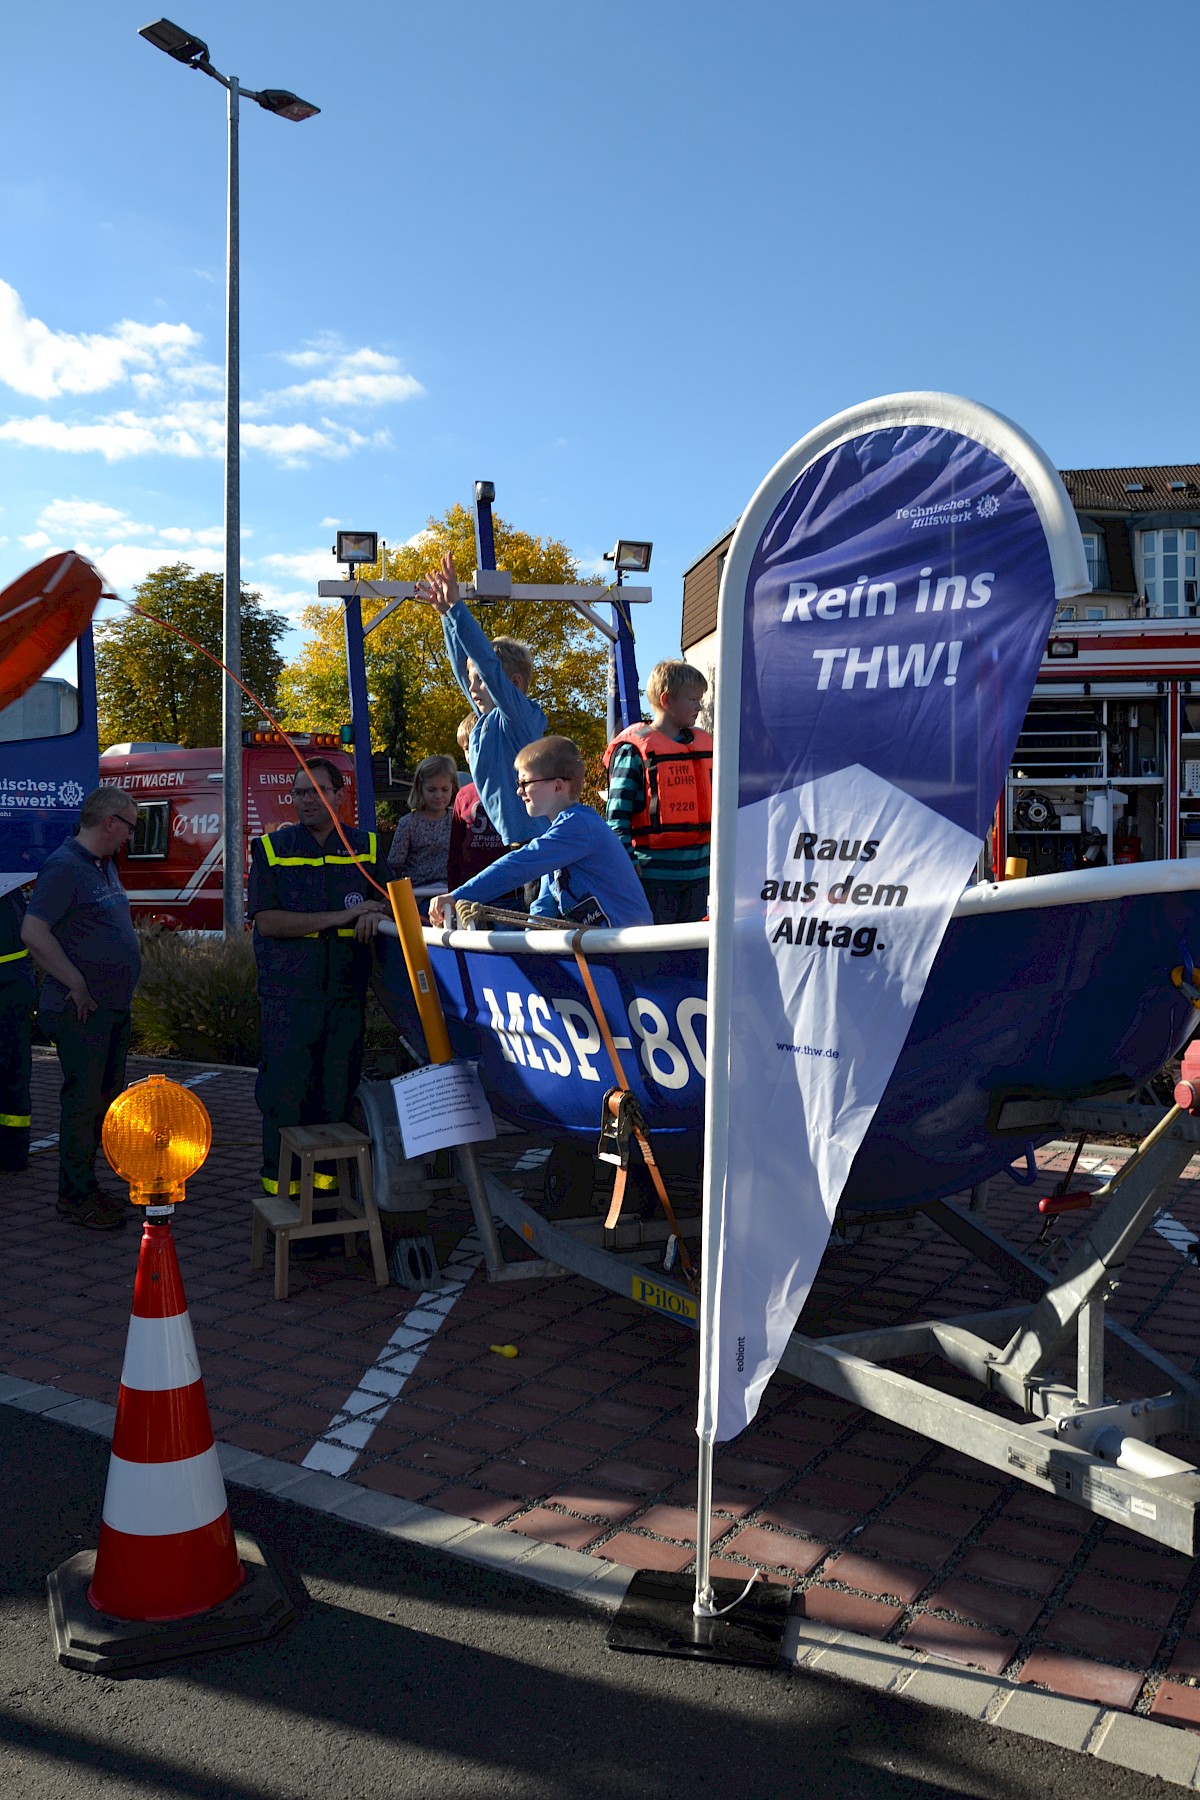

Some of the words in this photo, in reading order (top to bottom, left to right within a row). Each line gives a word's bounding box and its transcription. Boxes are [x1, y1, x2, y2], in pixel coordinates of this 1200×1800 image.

[896, 498, 971, 519] Technisches
[911, 511, 971, 529] Hilfswerk
[781, 575, 897, 622] Rein
[915, 567, 995, 613] ins
[812, 641, 963, 690] THW!
[667, 775, 695, 787] LOHR
[668, 765, 689, 775] THW
[190, 814, 220, 834] 112
[793, 832, 880, 862] Raus
[760, 879, 819, 903] aus
[827, 875, 909, 907] dem
[772, 917, 885, 957] Alltag.
[776, 1042, 840, 1059] www.thw.de
[736, 1336, 746, 1372] eobiont
